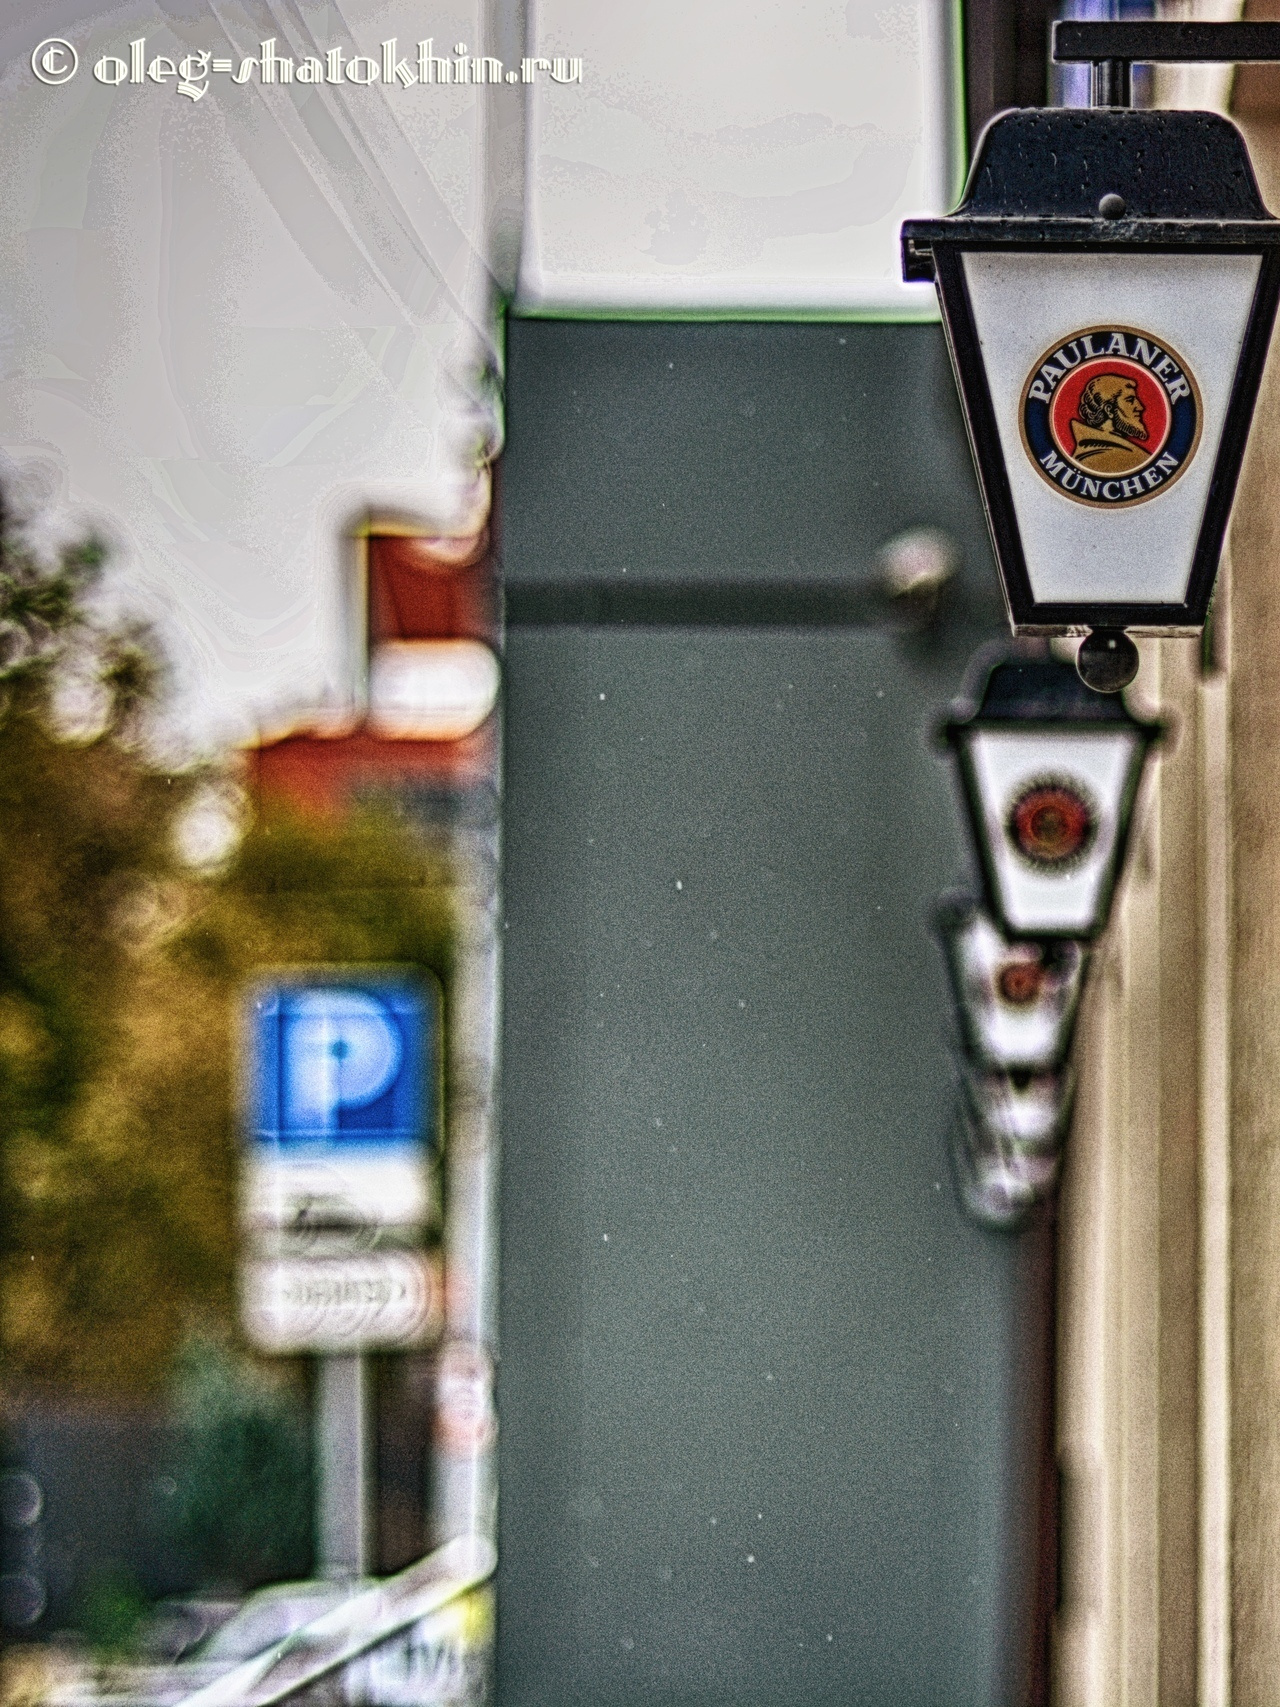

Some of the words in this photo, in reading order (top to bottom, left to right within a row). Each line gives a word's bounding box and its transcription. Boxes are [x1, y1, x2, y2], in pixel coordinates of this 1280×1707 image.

[1028, 332, 1191, 404] PAULANER
[1040, 450, 1179, 500] MÜNCHEN
[283, 986, 404, 1137] P
